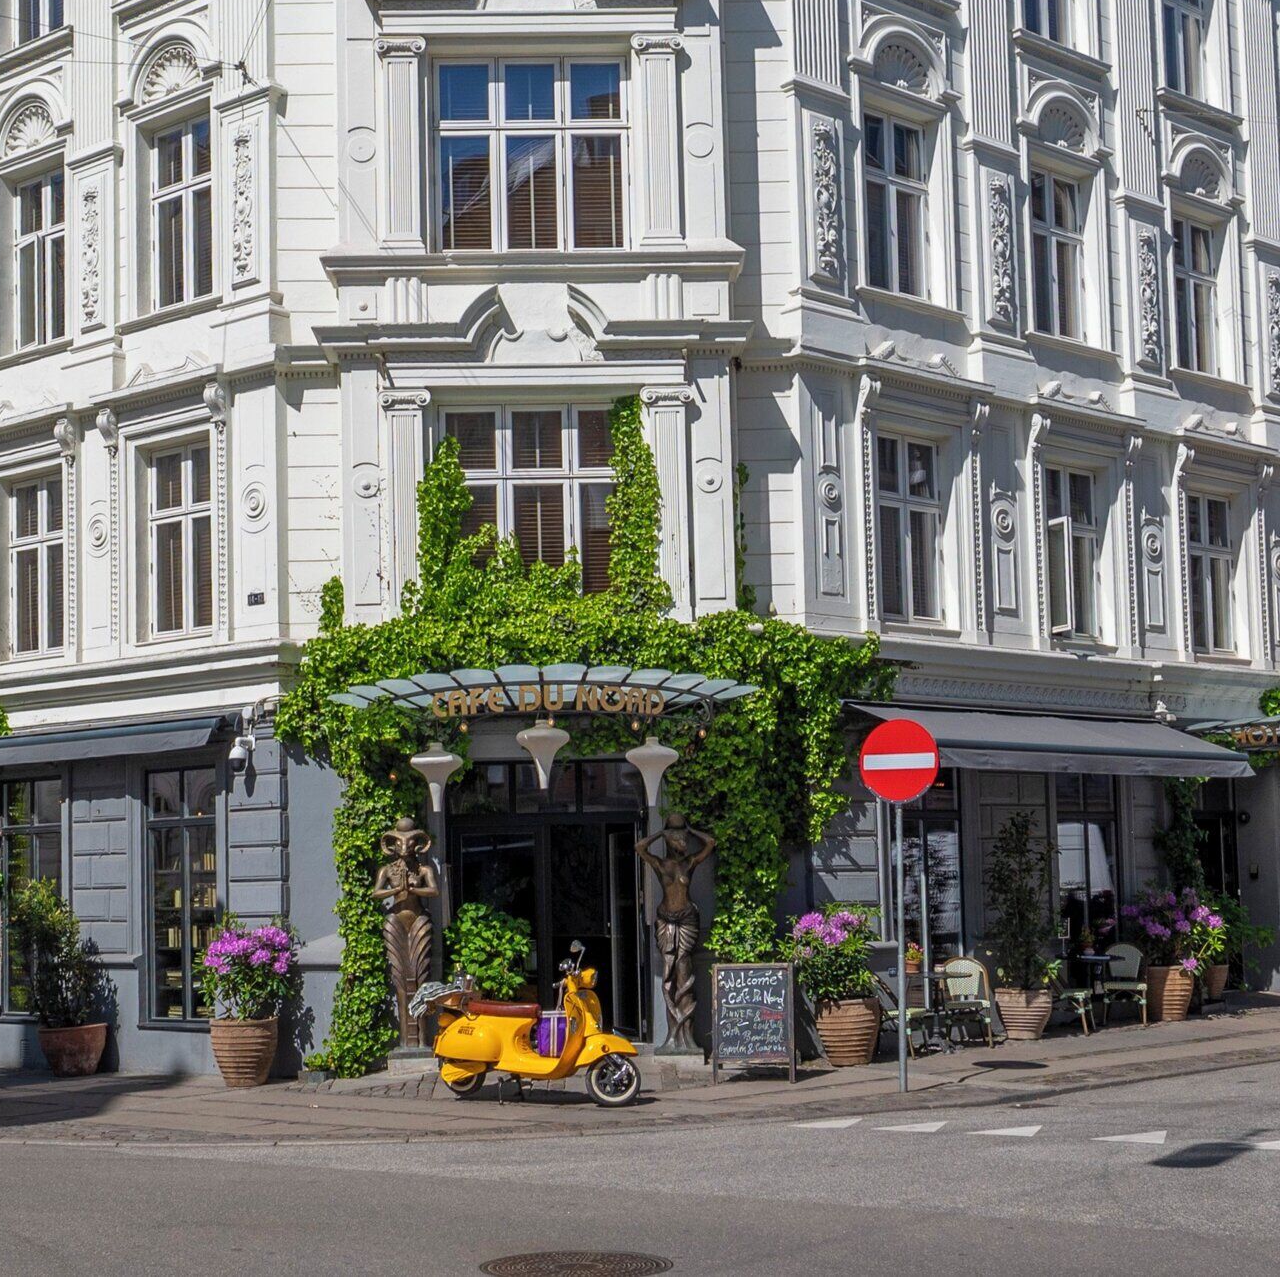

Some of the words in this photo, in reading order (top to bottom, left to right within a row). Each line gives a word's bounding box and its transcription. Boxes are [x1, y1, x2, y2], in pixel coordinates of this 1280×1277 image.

[432, 686, 505, 718] CAFE
[518, 684, 564, 712] DU
[576, 685, 665, 715] NORD
[719, 971, 778, 989] Welcome
